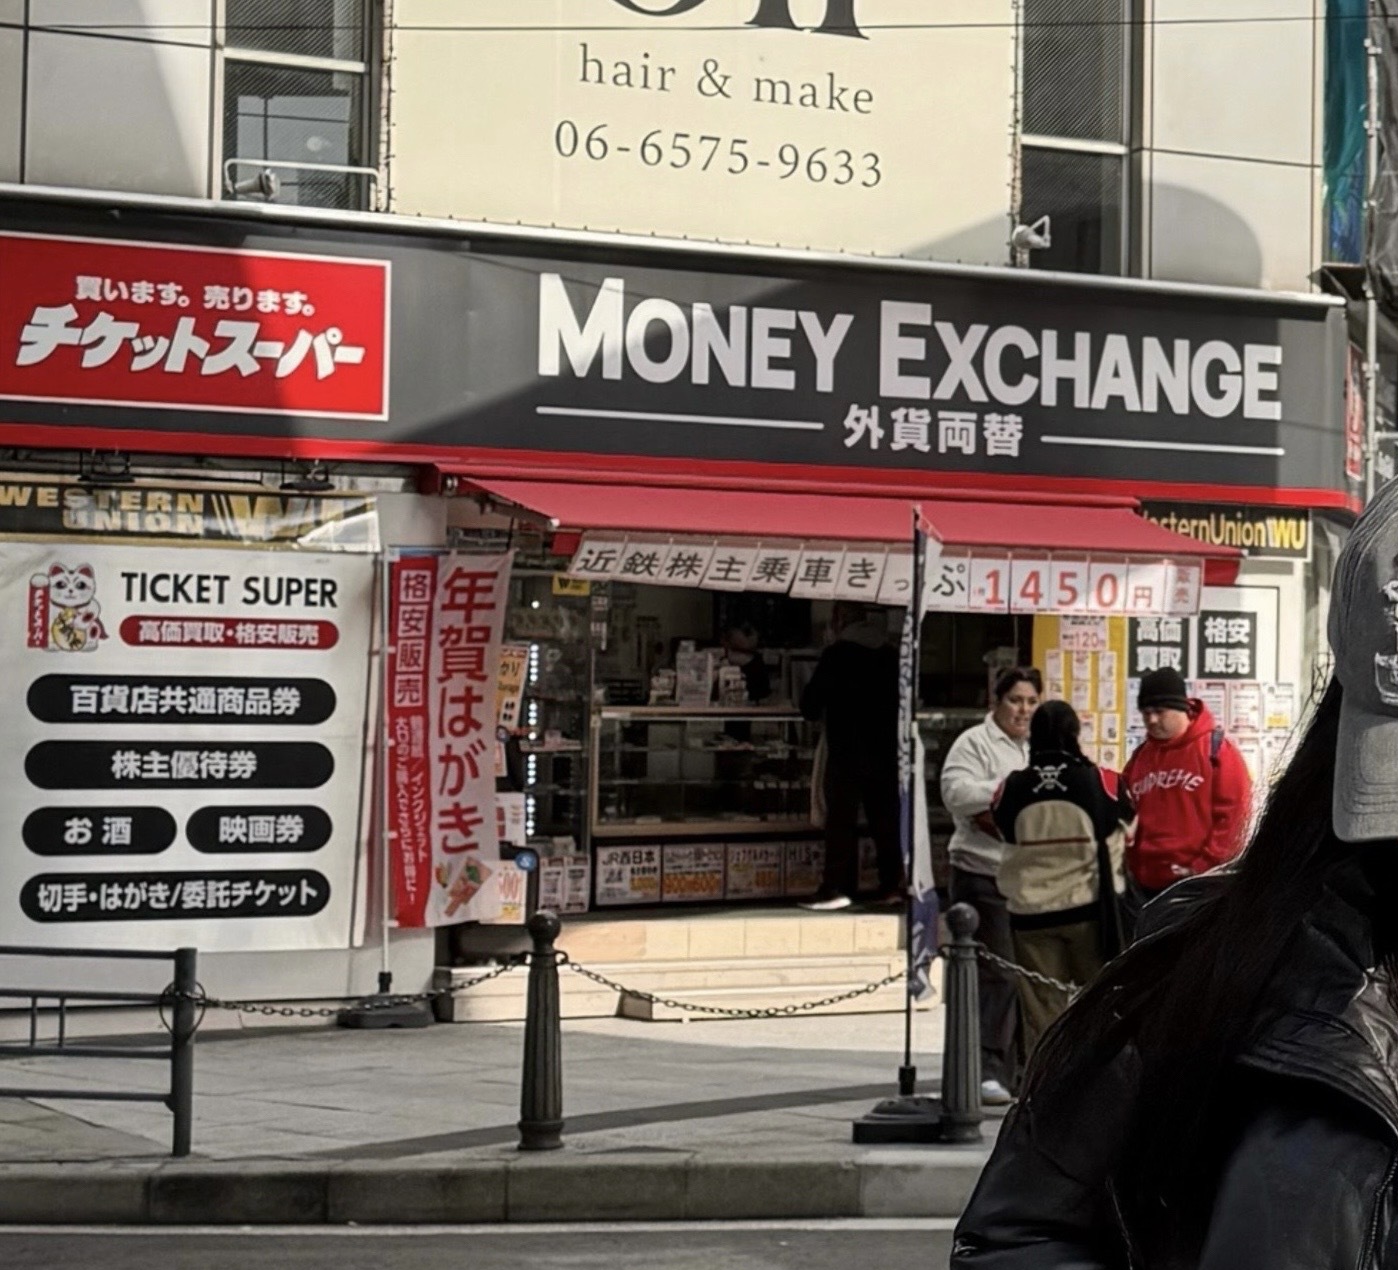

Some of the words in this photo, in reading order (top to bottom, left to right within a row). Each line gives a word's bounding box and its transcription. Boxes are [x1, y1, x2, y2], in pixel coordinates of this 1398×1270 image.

[579, 44, 676, 92] hair
[697, 58, 732, 98] &
[754, 73, 875, 114] make
[555, 120, 883, 187] 06-6575-9633
[76, 277, 315, 317] 買います。売ります。
[16, 304, 365, 380] チケットスーパー
[843, 405, 1024, 458] 外貨両替
[1272, 519, 1306, 549] WU
[121, 572, 230, 603] TICKET
[242, 577, 338, 608] SUPER
[138, 620, 319, 645] 高価買取・格安販売
[398, 573, 427, 704] 格安販売
[1204, 618, 1250, 643] 格安
[1204, 648, 1250, 674] 販売
[70, 685, 301, 715] 百貨店共通商品券
[438, 567, 498, 855] 年賀はがき
[111, 751, 257, 780] 株主優待券
[218, 815, 304, 844] 映画券
